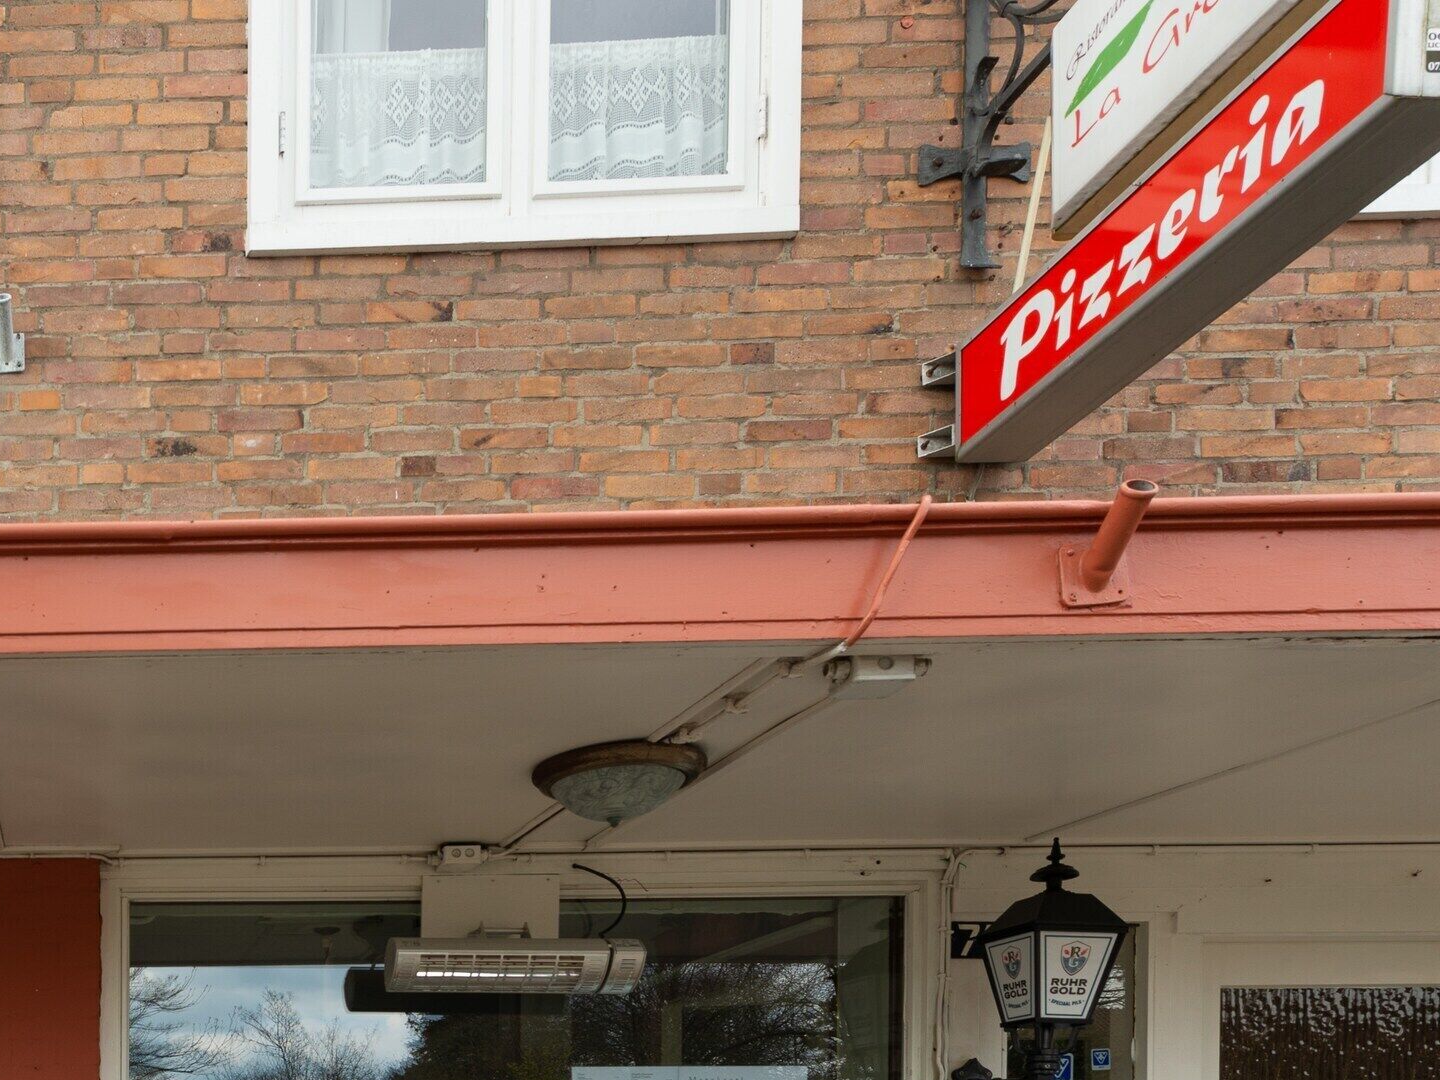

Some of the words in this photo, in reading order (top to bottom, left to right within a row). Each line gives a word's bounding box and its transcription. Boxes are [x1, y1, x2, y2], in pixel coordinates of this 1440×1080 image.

[1071, 87, 1121, 147] La
[999, 79, 1326, 401] Pizzeria
[1003, 979, 1027, 992] RUHR
[1050, 978, 1088, 987] RUHR
[1004, 988, 1028, 999] GOLD
[1049, 987, 1086, 995] GOLD
